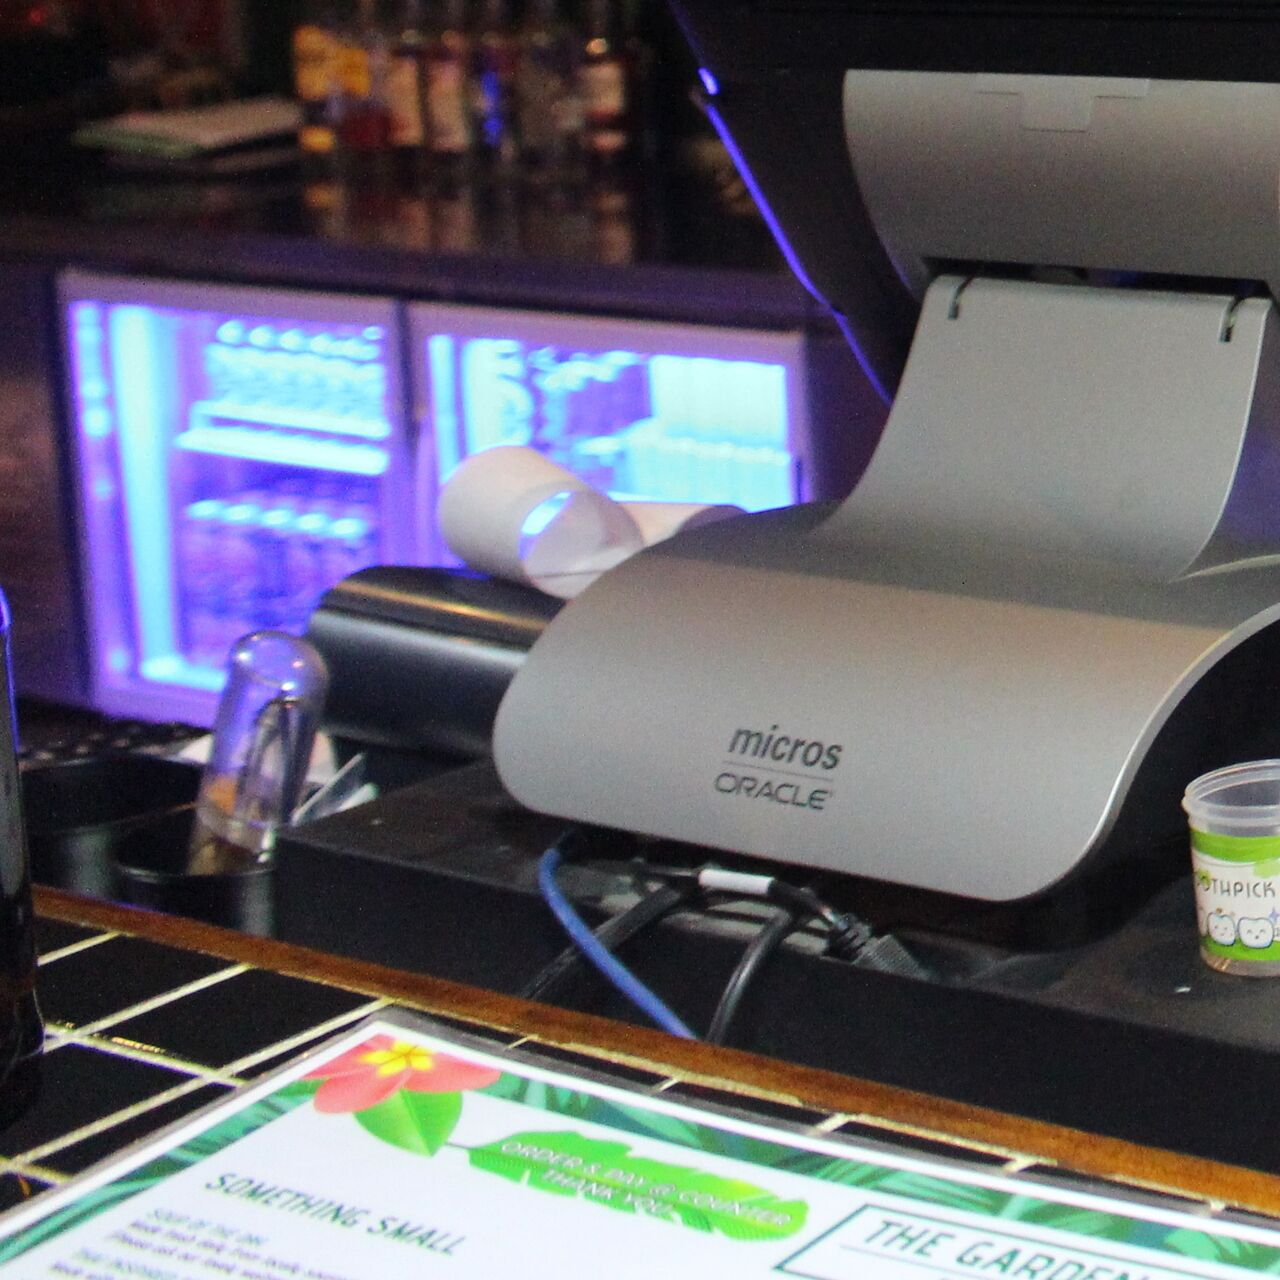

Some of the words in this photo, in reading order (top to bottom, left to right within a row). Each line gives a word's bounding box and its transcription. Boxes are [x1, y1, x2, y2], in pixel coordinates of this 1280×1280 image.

[728, 724, 843, 770] micros
[715, 772, 829, 810] ORACLE
[541, 1169, 613, 1201] THANK
[205, 1172, 373, 1229] SOMETHING
[366, 1216, 467, 1257] SMALL
[864, 1220, 956, 1258] THE
